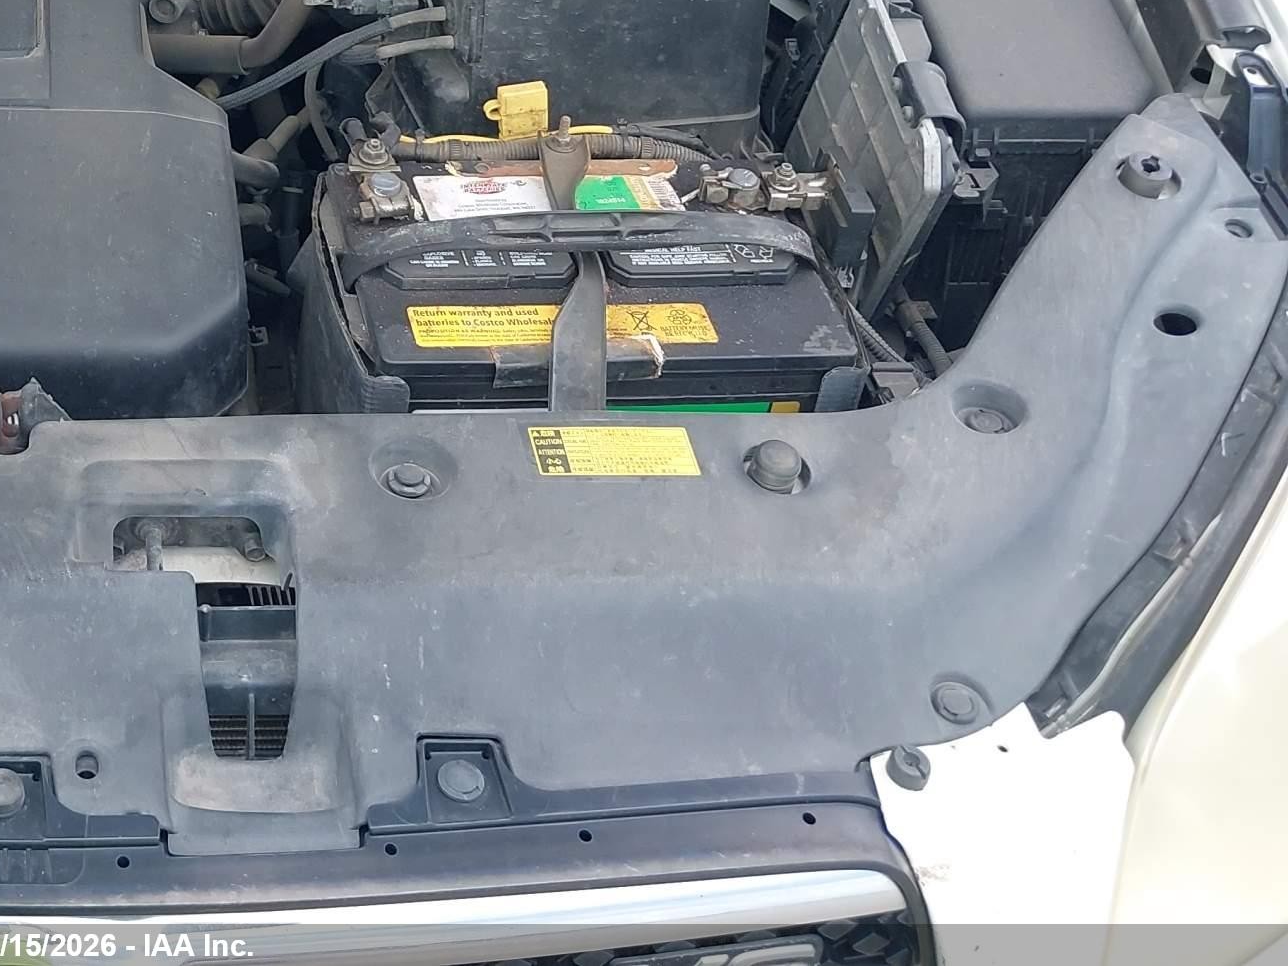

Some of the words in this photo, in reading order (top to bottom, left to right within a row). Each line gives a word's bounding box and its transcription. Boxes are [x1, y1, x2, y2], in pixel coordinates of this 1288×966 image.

[448, 309, 492, 318] warranty
[494, 308, 513, 316] and
[515, 307, 539, 315] used
[415, 318, 460, 326] batteries
[473, 318, 505, 326] Costco
[505, 317, 553, 325] Wholesal
[535, 438, 563, 446] CAUTION
[538, 448, 566, 456] ATTENTION
